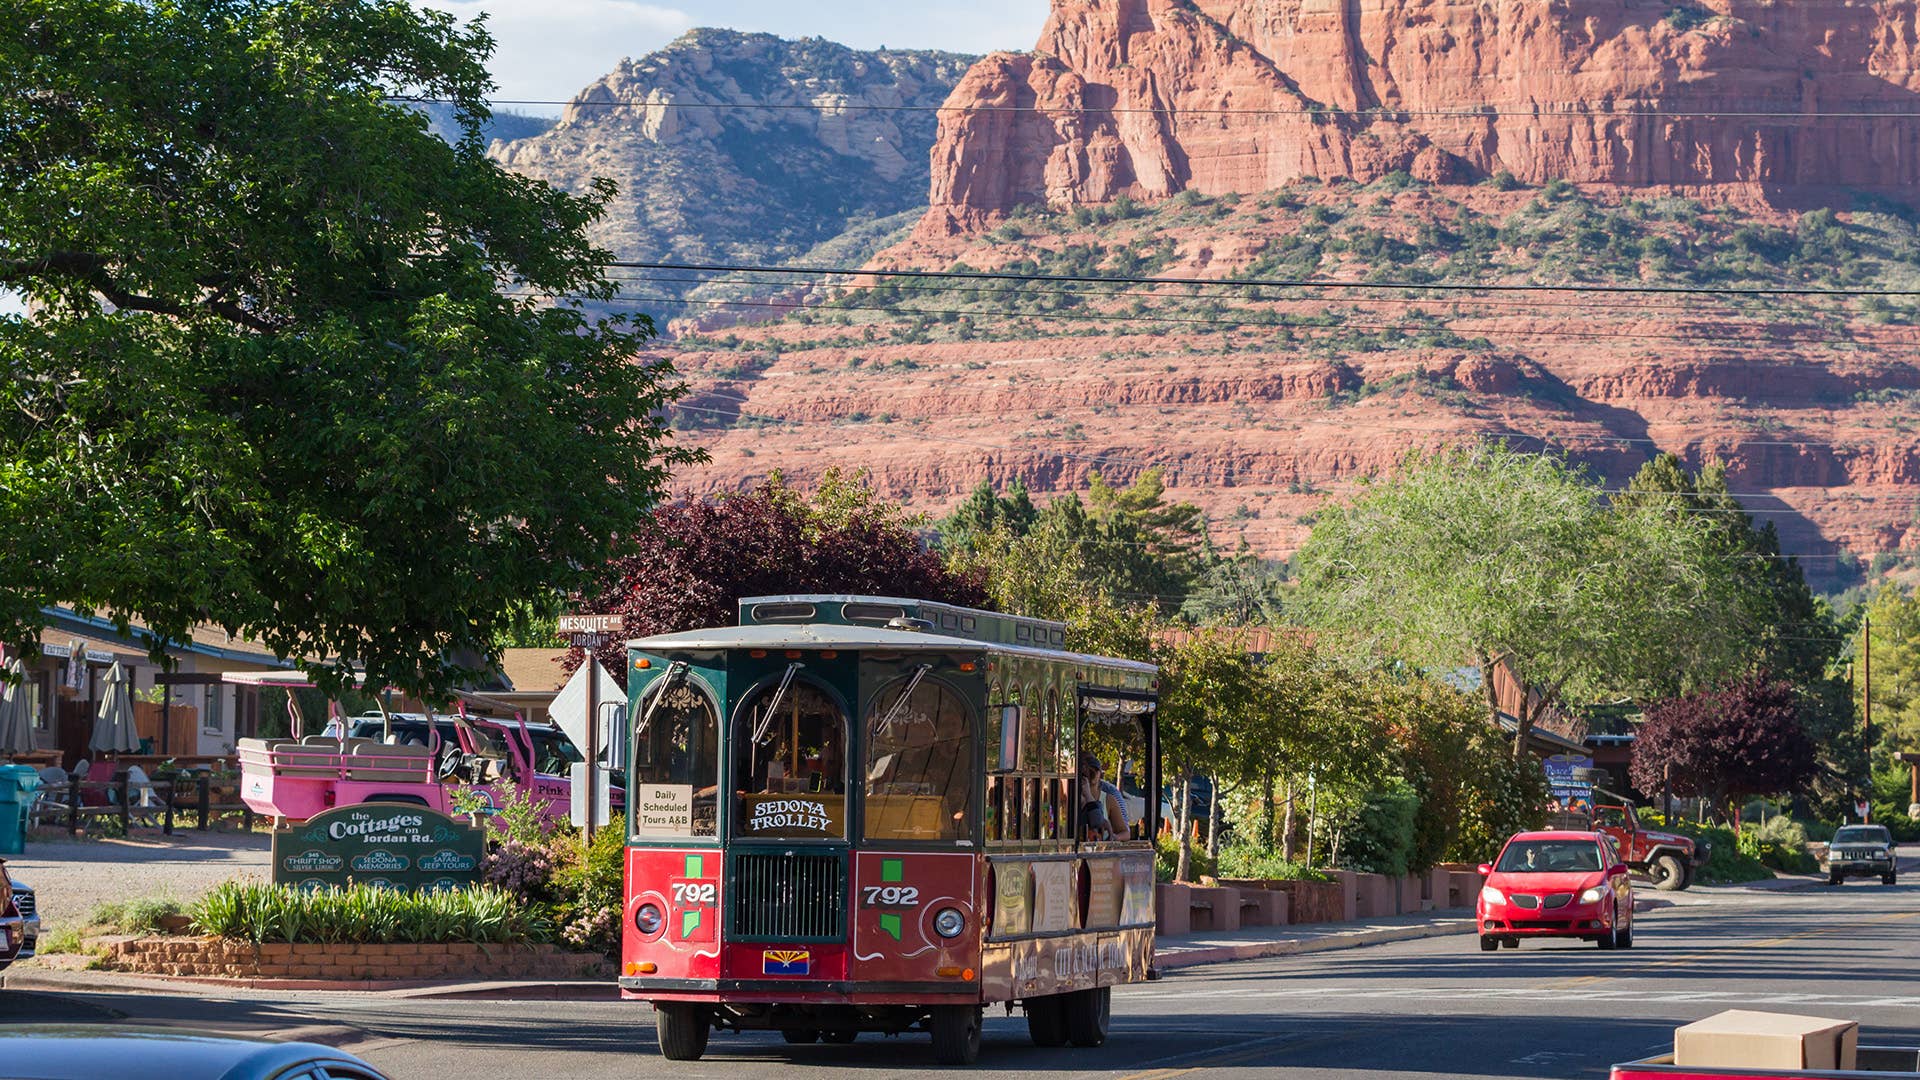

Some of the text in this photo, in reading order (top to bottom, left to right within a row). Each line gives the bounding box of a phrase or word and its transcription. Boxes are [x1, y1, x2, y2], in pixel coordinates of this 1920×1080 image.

[560, 616, 621, 630] MESQUITE AVE
[571, 634, 601, 647] JORDAN
[538, 785, 564, 796] Pink
[655, 790, 677, 801] Daily
[643, 802, 688, 812] Scheduled
[755, 799, 828, 818] SEDONA
[351, 812, 370, 821] the
[643, 815, 688, 825] Tours A&B
[750, 813, 833, 832] TROLLEY
[329, 814, 423, 840] Cottages
[405, 827, 419, 835] on
[363, 834, 434, 843] Jordan Rd.
[672, 883, 715, 902] 792
[863, 886, 919, 905] 792
